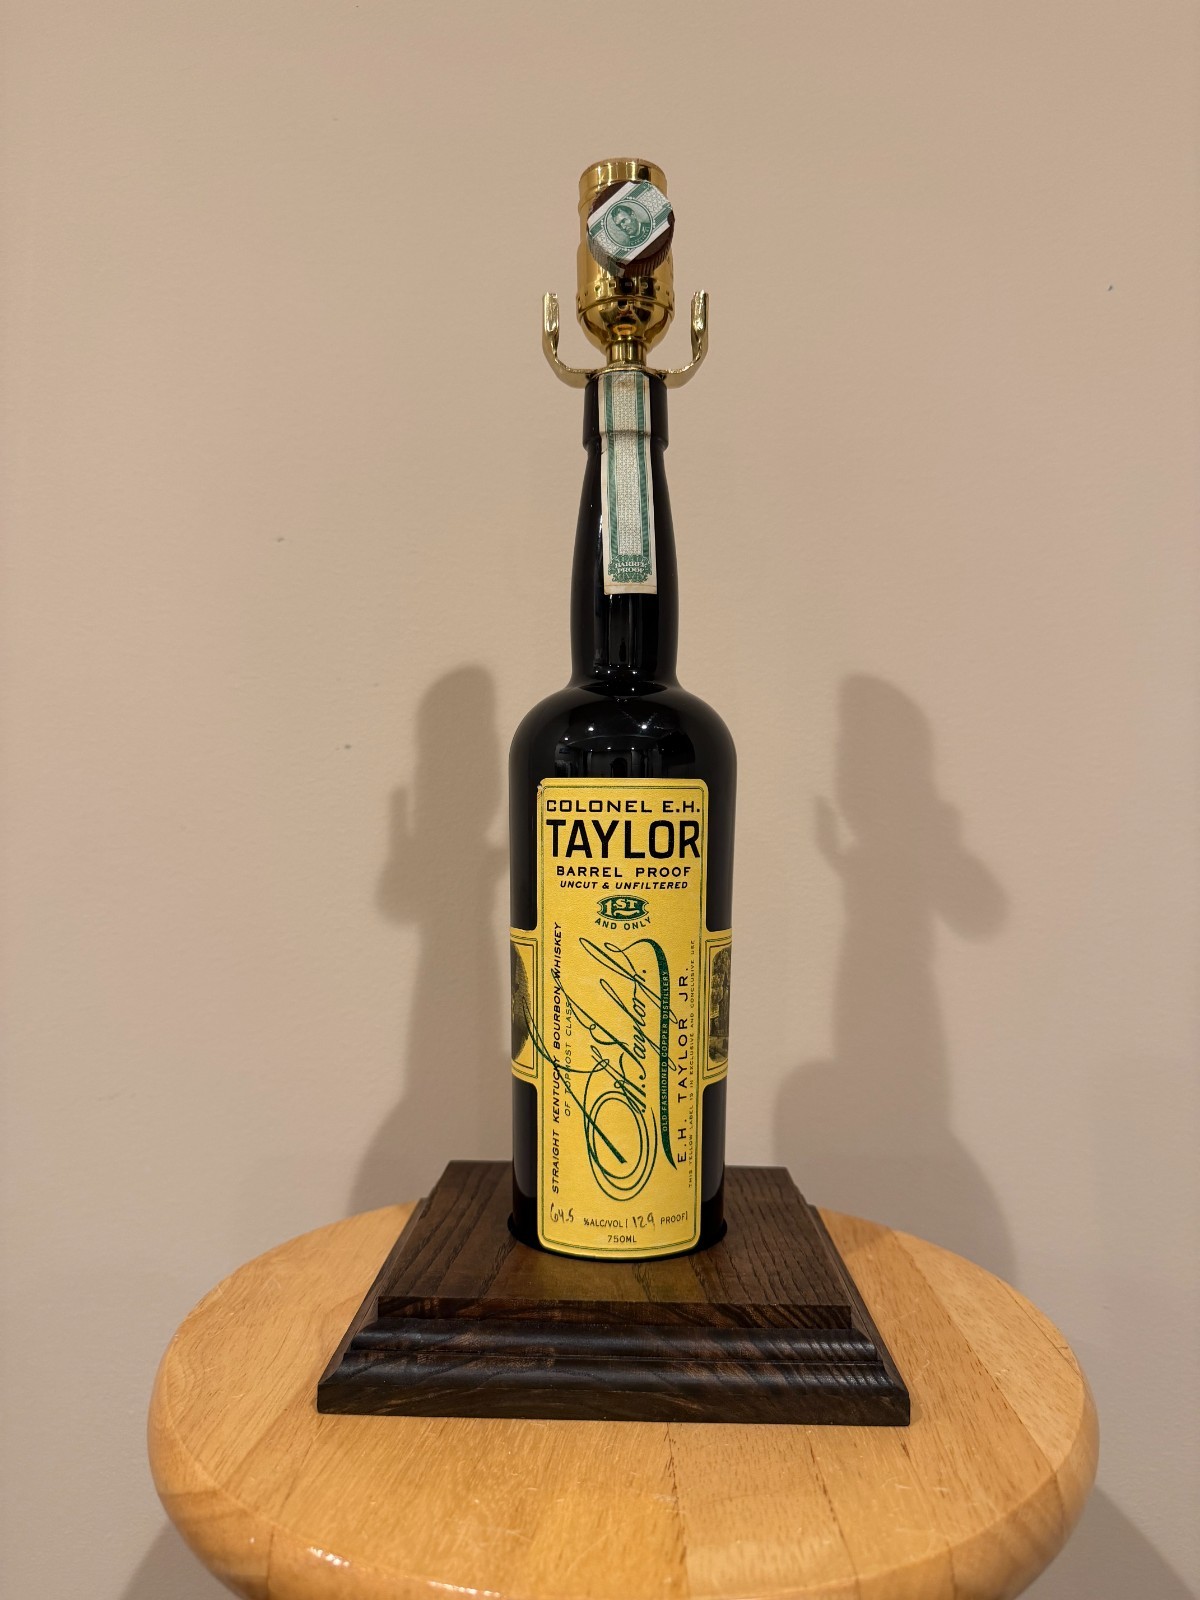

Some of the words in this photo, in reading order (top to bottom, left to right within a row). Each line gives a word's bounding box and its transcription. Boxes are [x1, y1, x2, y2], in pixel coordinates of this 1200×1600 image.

[546, 800, 652, 813] COLONEL
[662, 800, 700, 813] E.H.
[546, 819, 700, 859] TAYLOR
[556, 866, 622, 878] BARREL
[635, 866, 691, 878] PROOF
[560, 880, 598, 889] UNCUT
[602, 881, 610, 890] &
[615, 881, 688, 890] UNFILTERED
[595, 917, 617, 930] AND
[624, 916, 651, 930] ONLY
[553, 921, 561, 980] WHISKEY
[661, 970, 669, 1019] DISTILLERY
[678, 968, 688, 1002] JR.
[553, 986, 561, 1049] BOURBON
[678, 1018, 688, 1103] TAYLOR
[552, 1055, 560, 1123] KENTUCKY
[564, 1101, 571, 1117] OF
[678, 1119, 687, 1163] E.H.
[552, 1129, 560, 1194] STRAIGHT
[607, 1234, 637, 1243] 750ML
